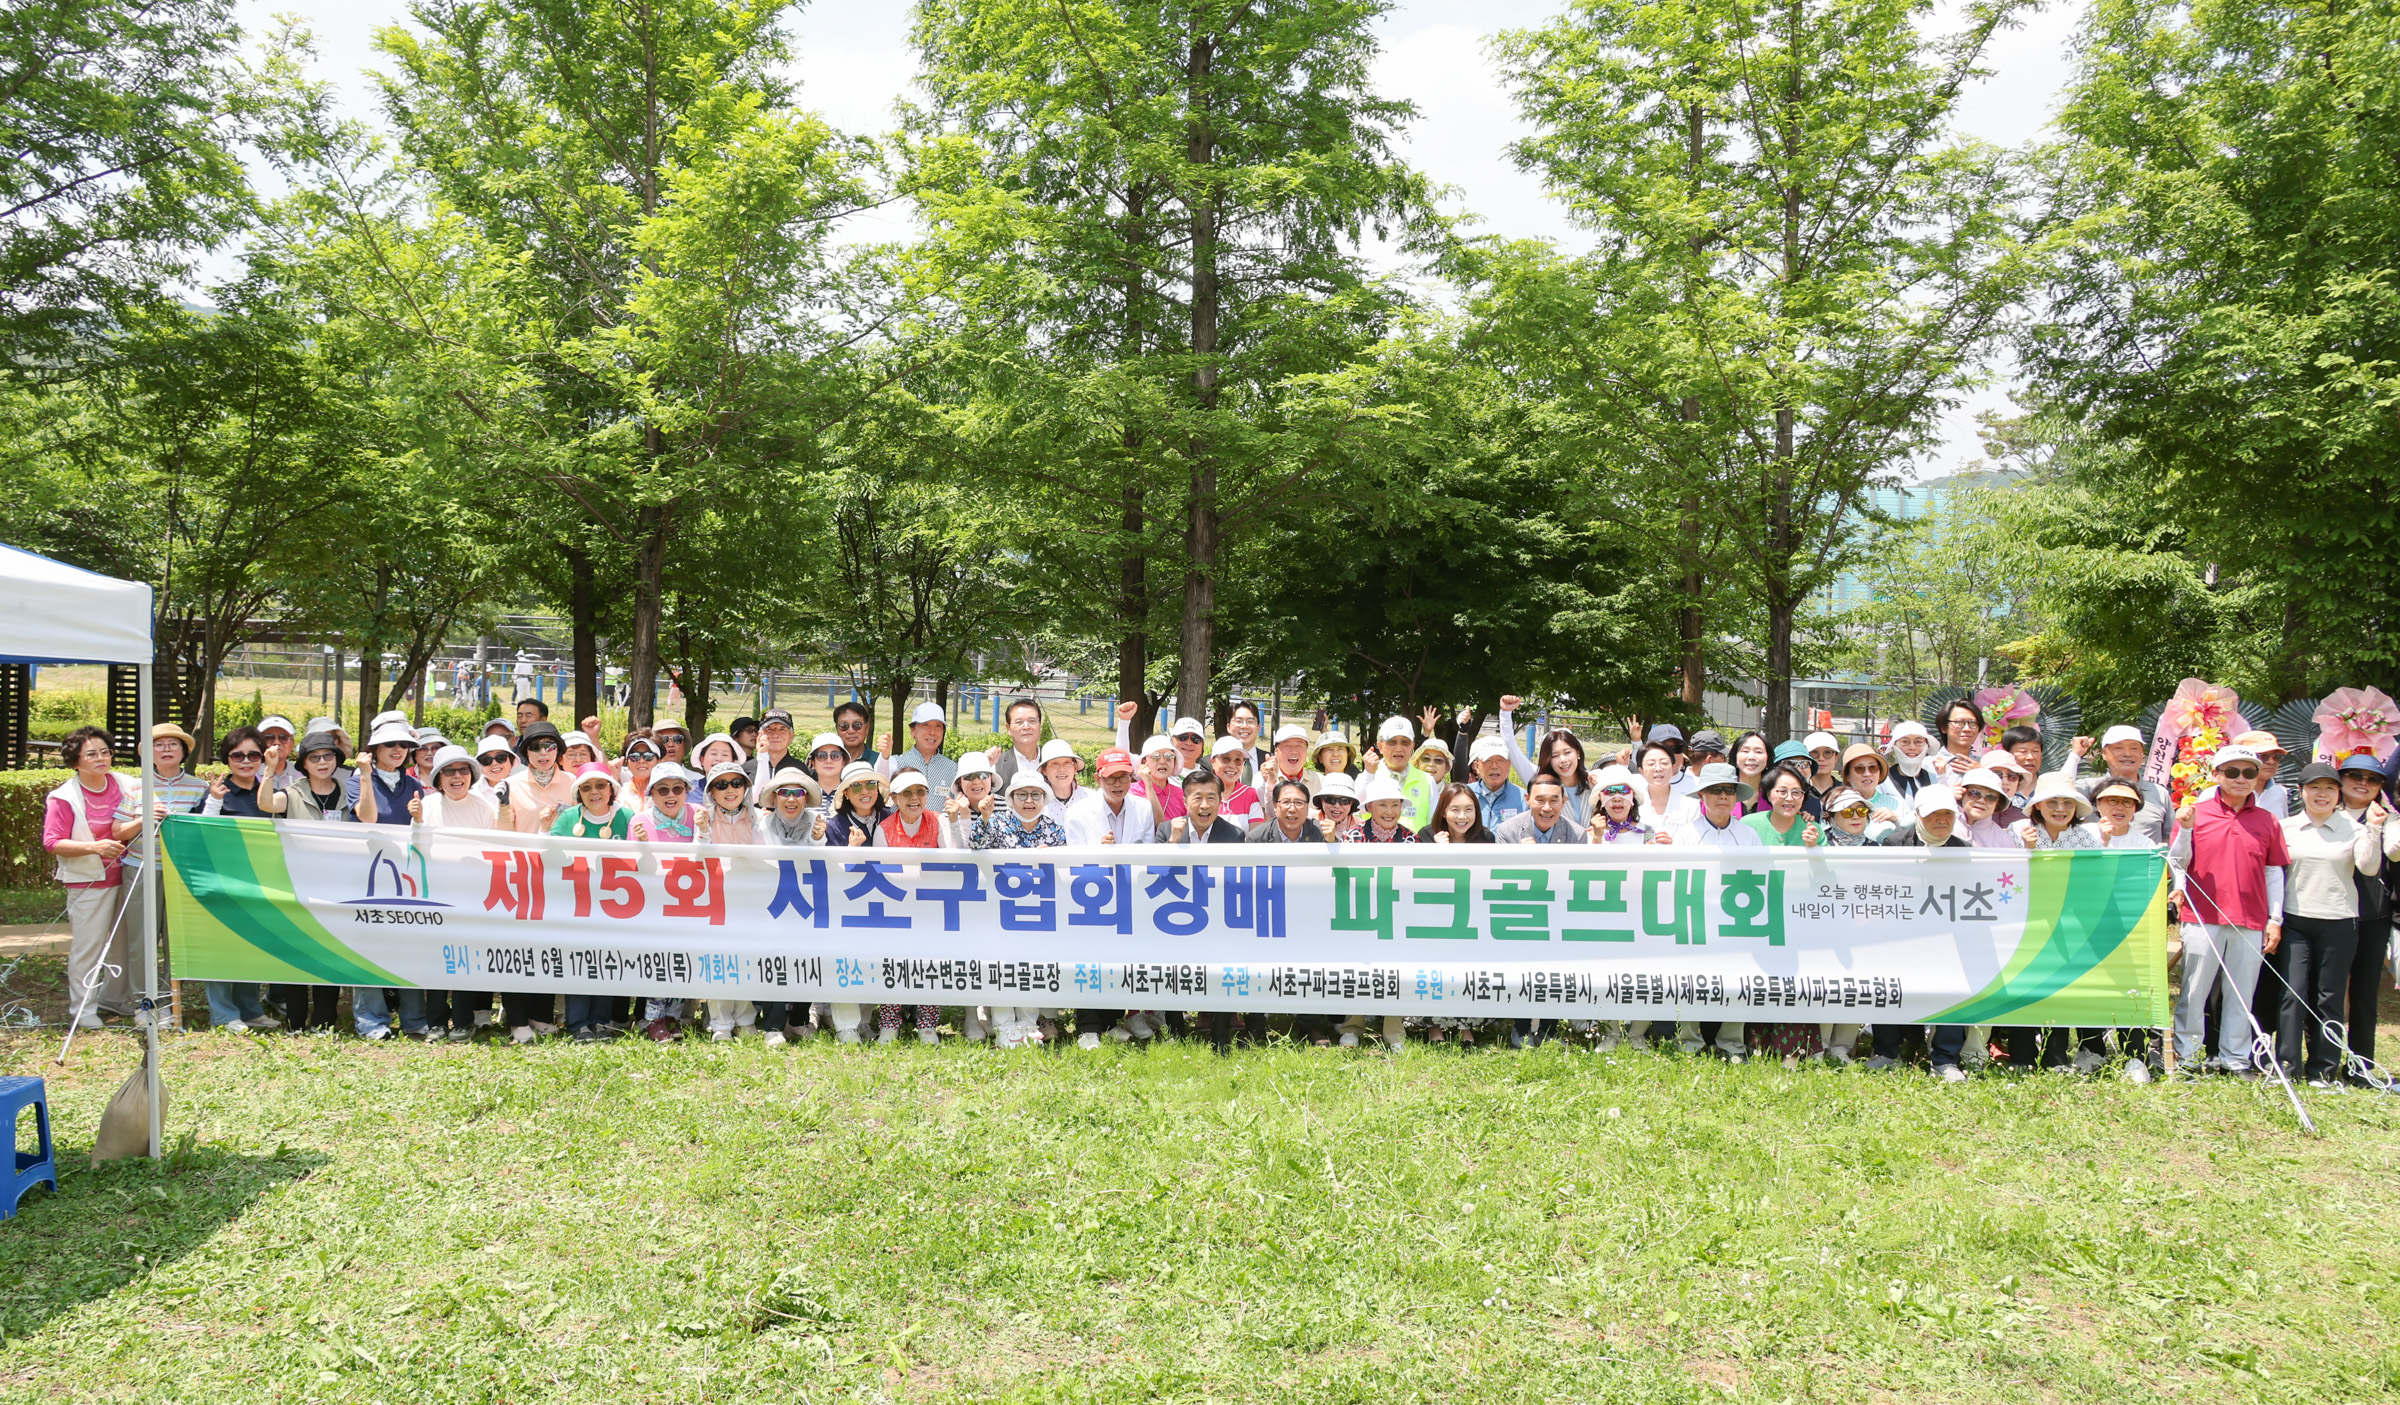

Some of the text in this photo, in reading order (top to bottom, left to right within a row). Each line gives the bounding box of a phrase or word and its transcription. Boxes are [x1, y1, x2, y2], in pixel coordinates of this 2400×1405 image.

[767, 859, 1287, 938] 서초구협회장배
[1331, 866, 1786, 946] 파크골프대회
[1817, 884, 1914, 900] 오늘 행복하고
[1919, 882, 1998, 922] 서초
[355, 909, 443, 925] 서초 SEOCHO
[1791, 903, 1914, 920] 내일이 기다려지는
[443, 944, 470, 975] 일시
[486, 947, 535, 977] 2026년
[542, 947, 564, 978] 6월
[569, 949, 692, 983] 17일(수)~18일(목)
[698, 953, 740, 984] 개회식
[757, 955, 787, 986] 18일
[794, 956, 822, 987] 11시
[835, 957, 865, 988] 장소
[882, 958, 982, 990] 청계산수변공원
[988, 960, 1061, 993] 파크골프장
[1074, 963, 1103, 993] 주최
[1121, 964, 1207, 996] 서초구체육회
[1221, 966, 1251, 997] 주관
[1268, 967, 1400, 1000] 서초구파크골프협회
[1415, 969, 1444, 1000] 후원
[1462, 970, 1511, 1004] 서초구,
[1518, 971, 1598, 1005] 서울특별시,
[1605, 973, 1730, 1007] 서울특별시체육회,
[1737, 975, 1904, 1009] 서울특별시파크골프협회
